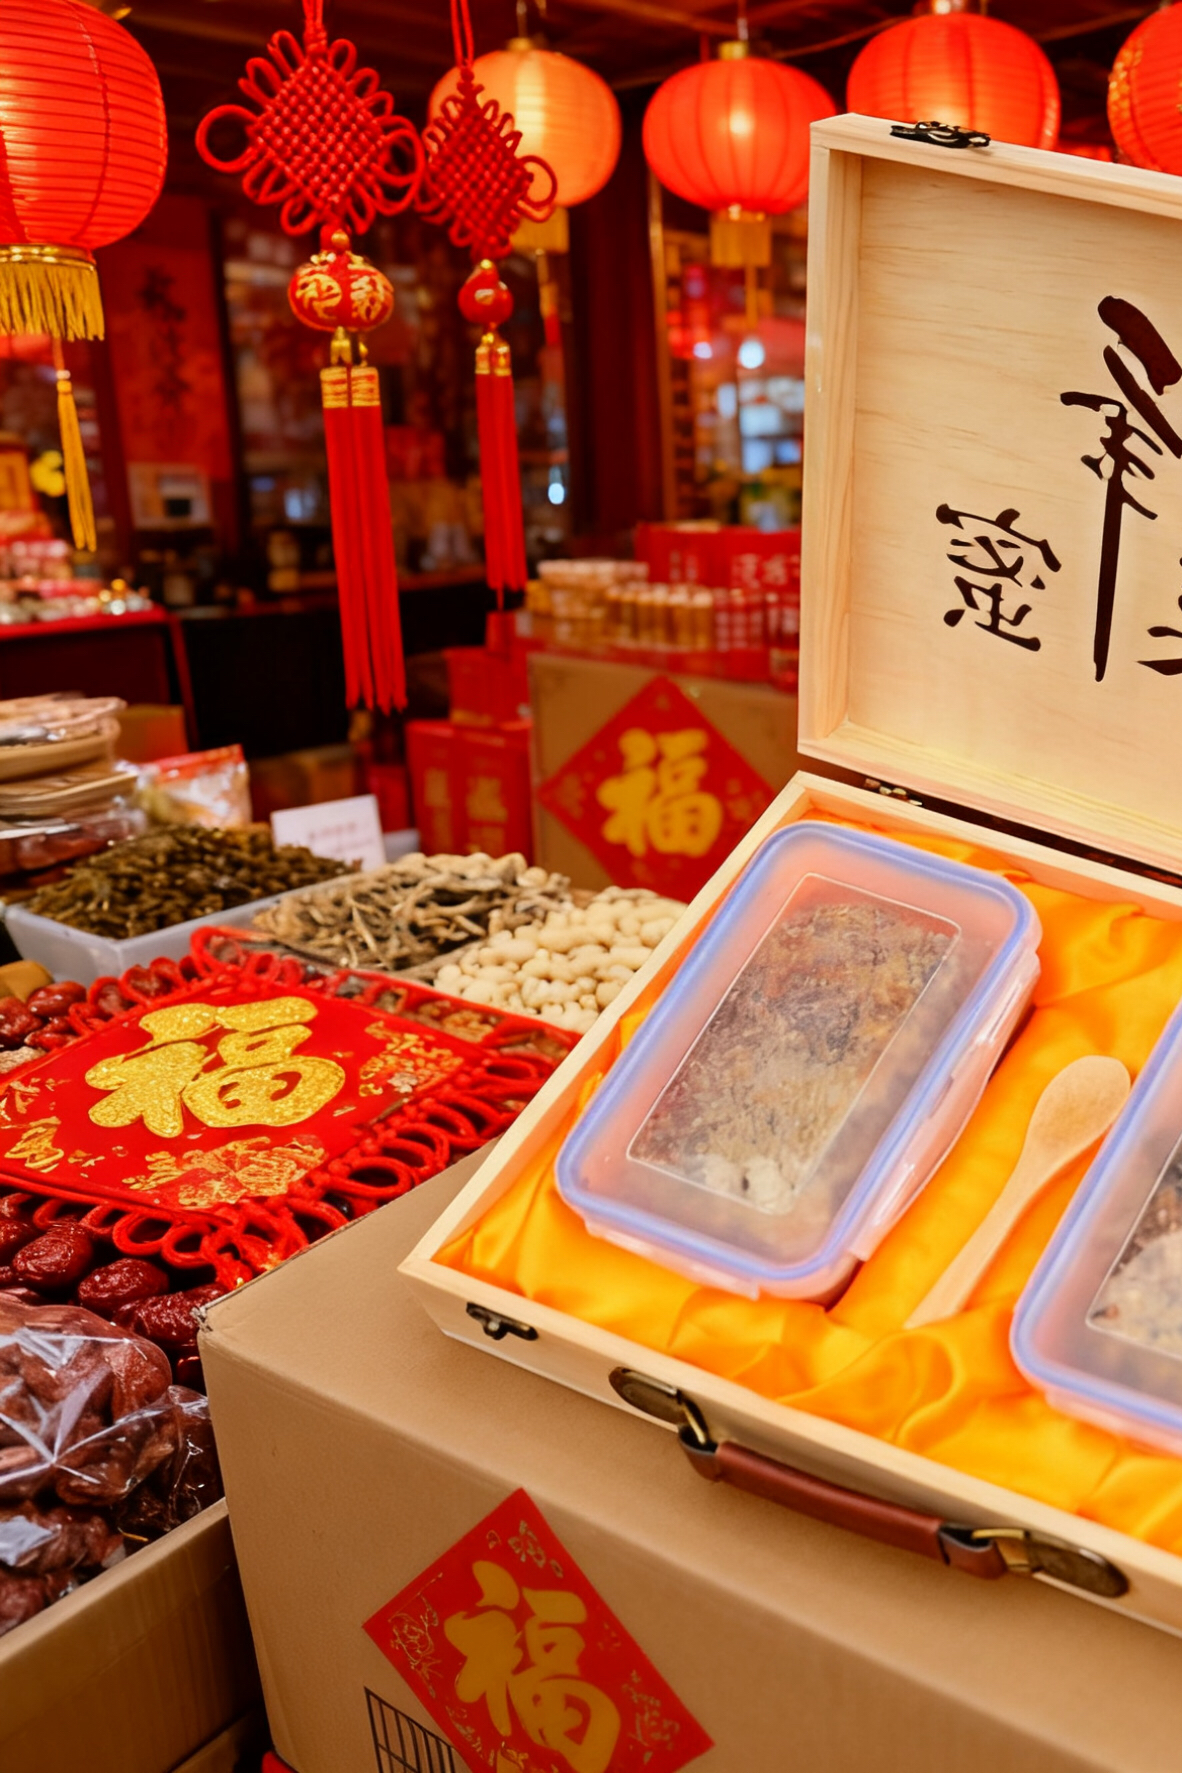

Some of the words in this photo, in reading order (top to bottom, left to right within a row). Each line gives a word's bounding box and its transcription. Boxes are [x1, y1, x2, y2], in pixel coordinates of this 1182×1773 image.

[597, 728, 724, 858] 福
[84, 996, 346, 1138] 福
[444, 1560, 622, 1773] 福
